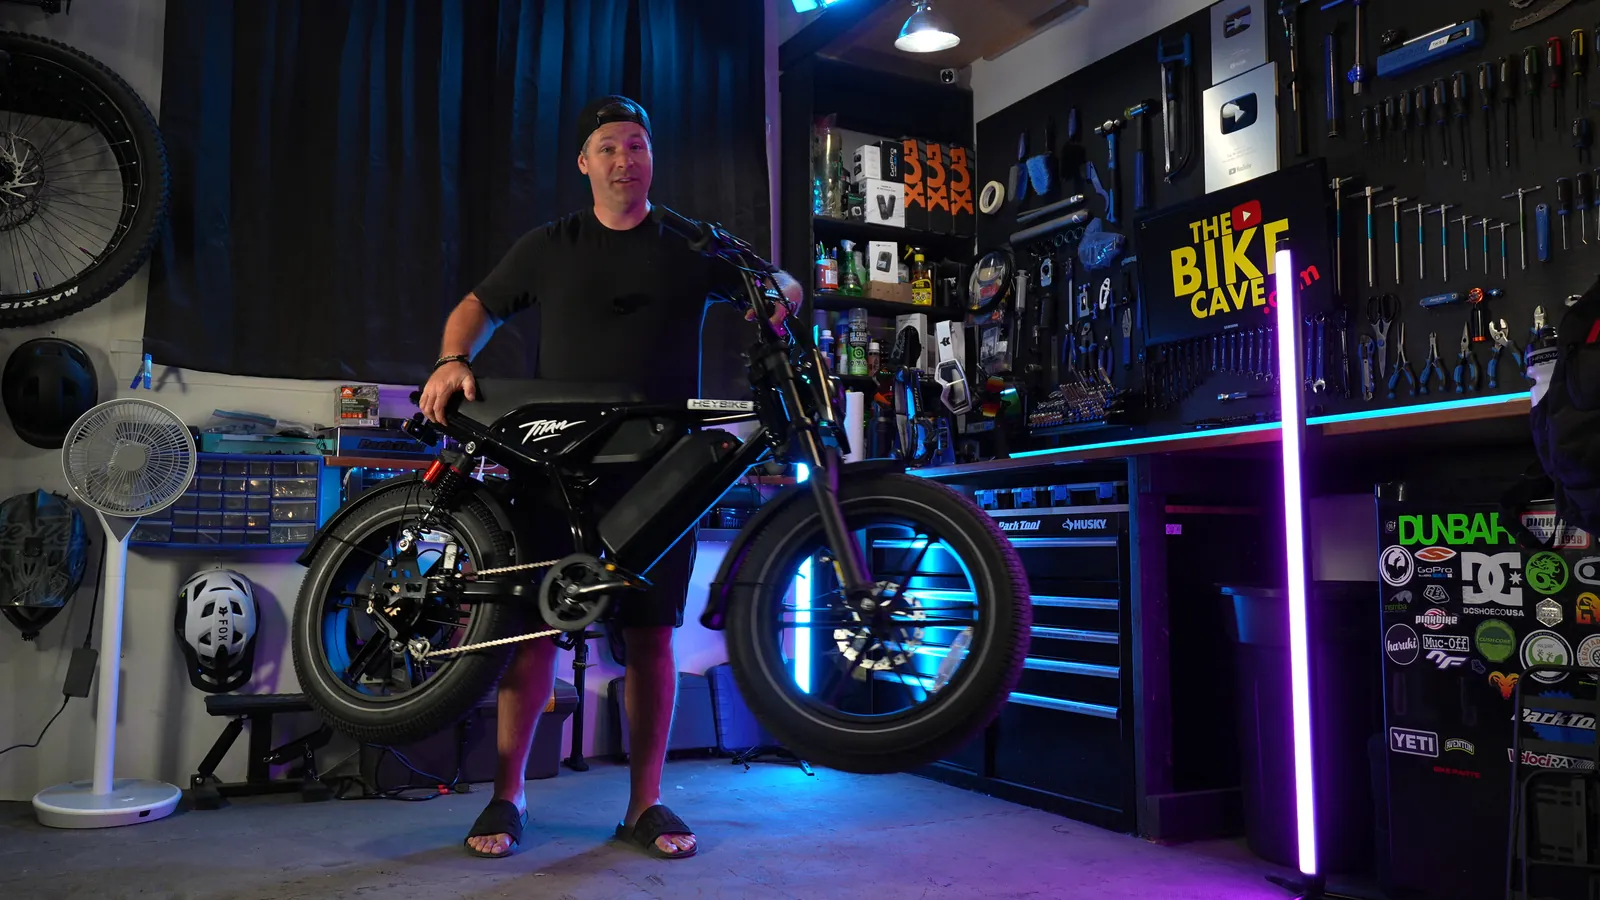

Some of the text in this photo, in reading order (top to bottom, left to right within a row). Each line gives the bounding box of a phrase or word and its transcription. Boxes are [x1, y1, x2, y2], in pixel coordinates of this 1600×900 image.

[1189, 212, 1232, 244] THE
[0, 286, 79, 309] MAXXIS
[1190, 276, 1266, 319] CAVE
[692, 400, 749, 410] HEYBIKE
[998, 519, 1041, 531] Park Tool
[1073, 519, 1108, 531] HUSKY
[1417, 566, 1454, 574] GoPro
[1415, 615, 1458, 625] pinkbike
[218, 619, 229, 641] FOX
[1387, 637, 1418, 652] haruki
[1425, 637, 1467, 650] Muc-Off
[1393, 732, 1434, 752] YETI
[1446, 739, 1474, 753] AVENTON
